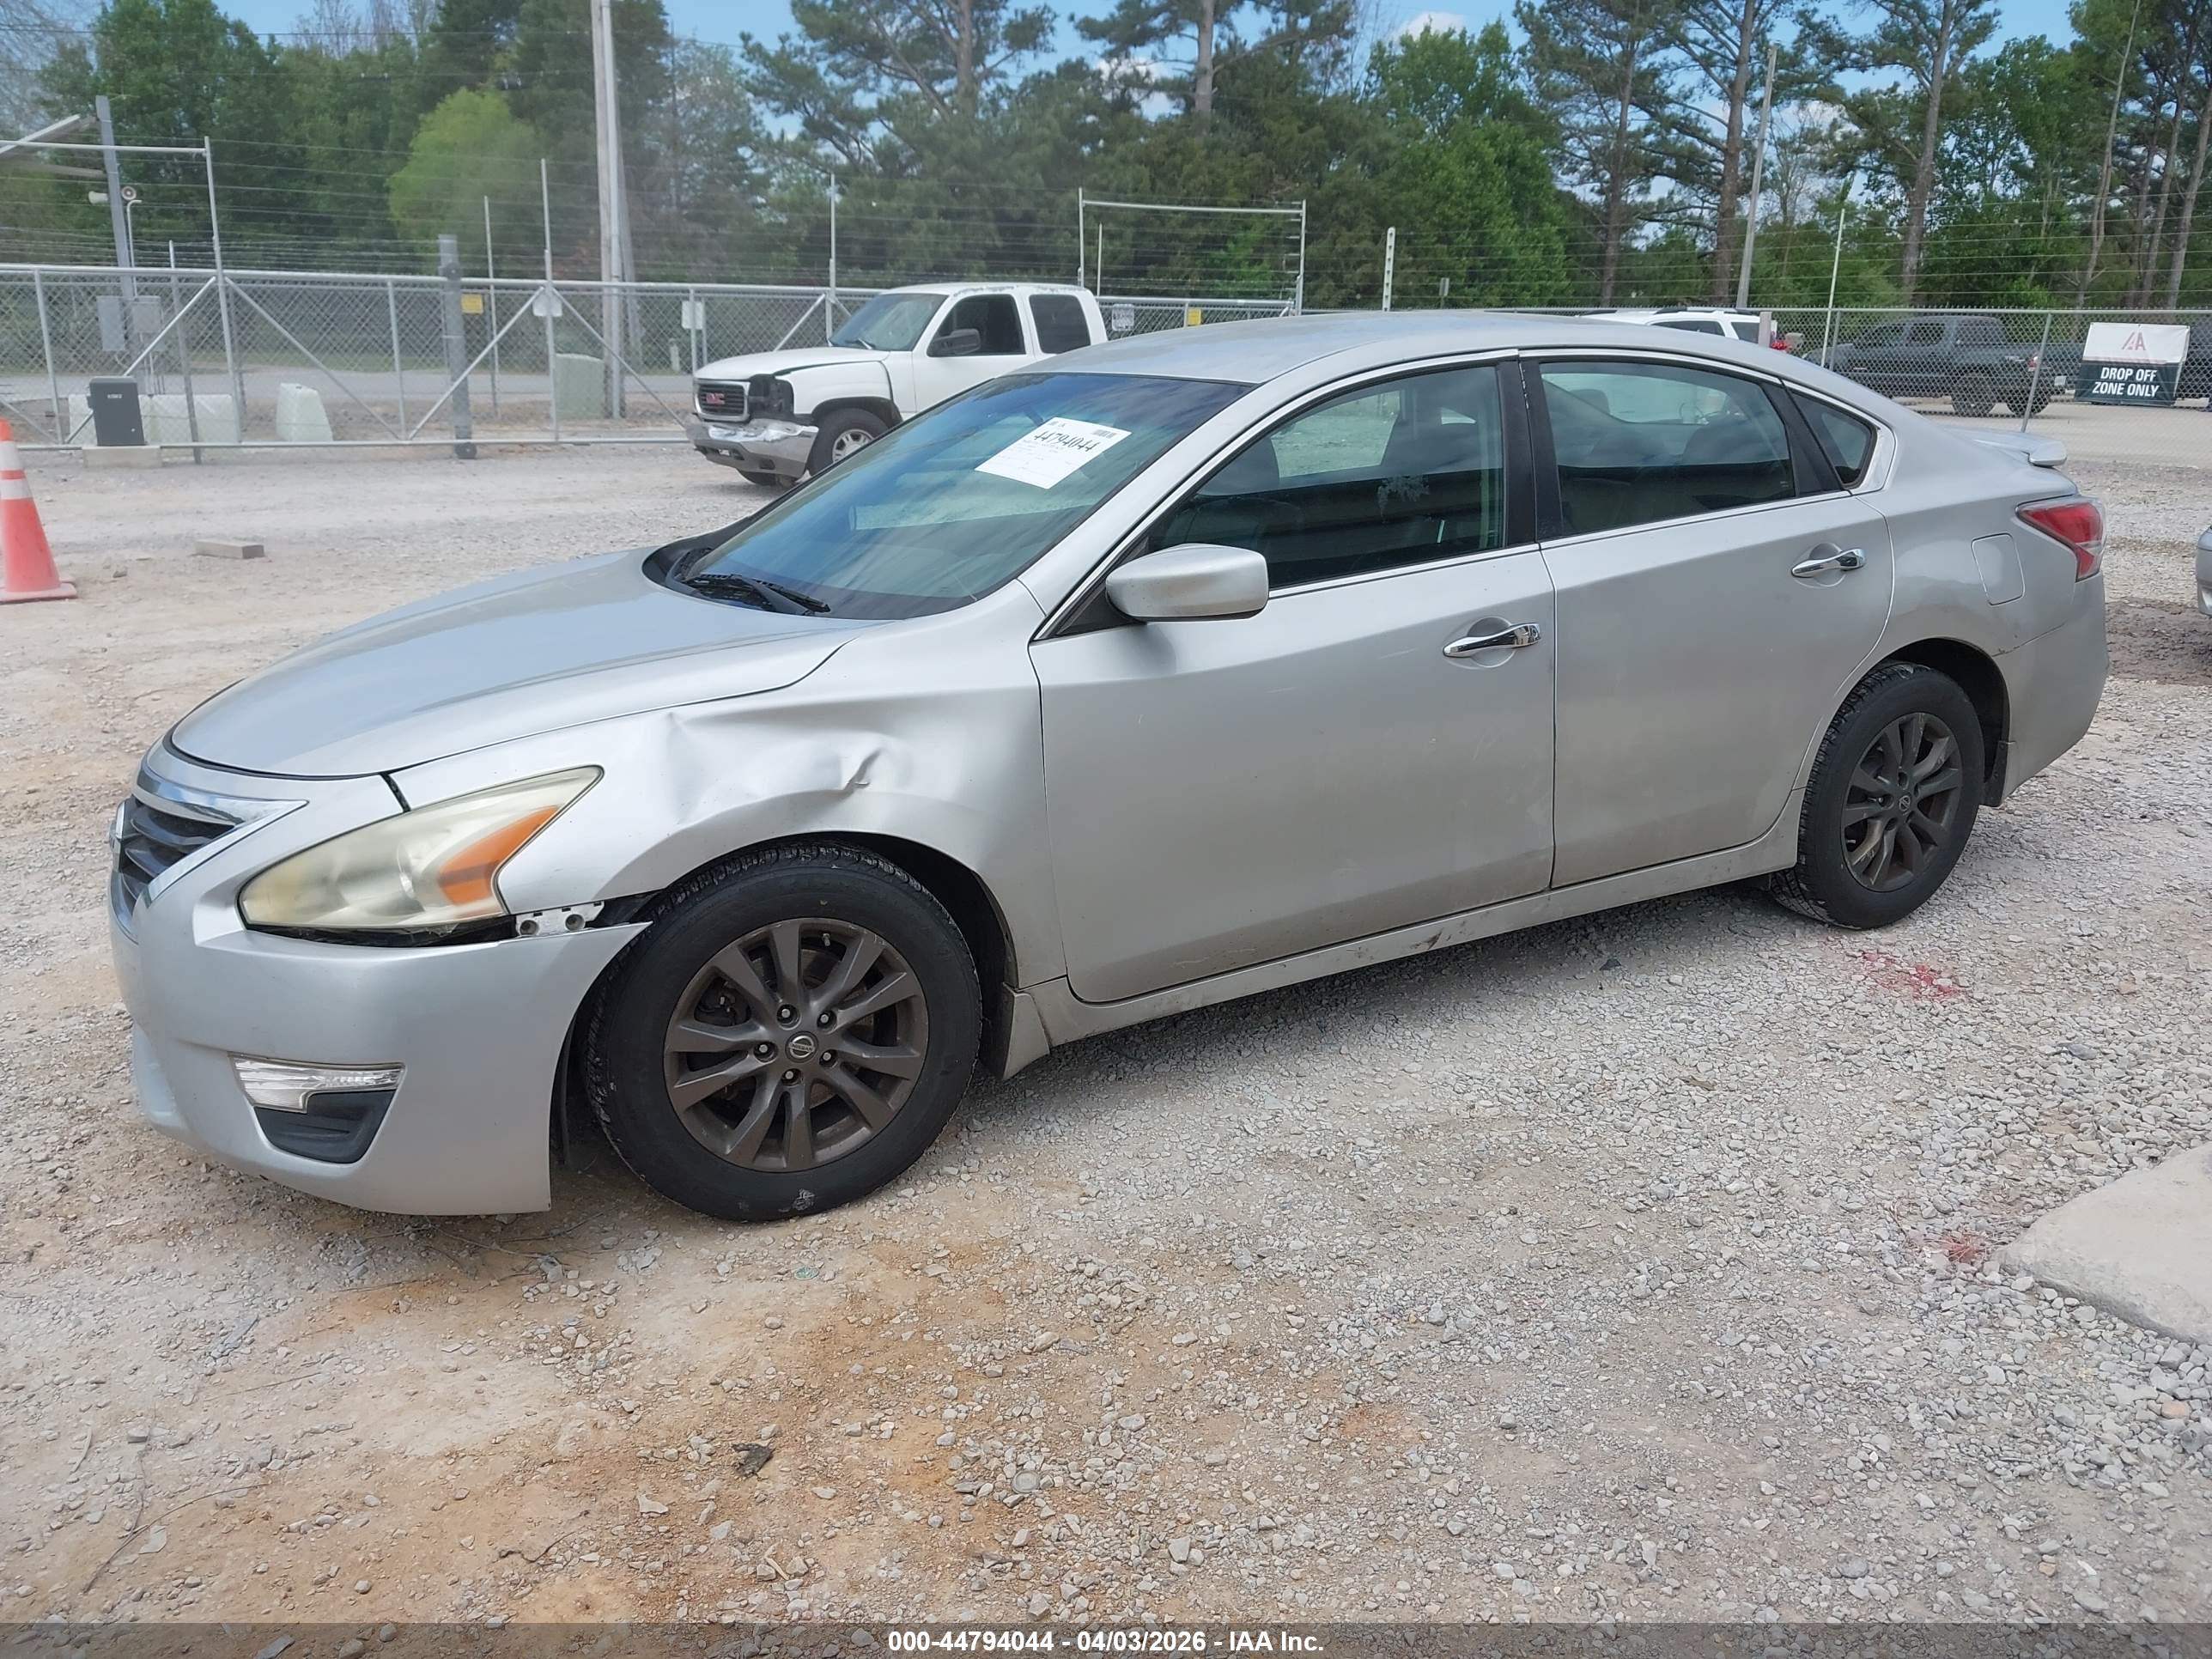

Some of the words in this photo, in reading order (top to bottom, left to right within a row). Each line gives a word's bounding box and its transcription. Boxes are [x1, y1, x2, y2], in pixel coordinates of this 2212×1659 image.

[2100, 367, 2133, 380] DROP
[2136, 369, 2157, 382] OFF
[2092, 381, 2125, 395] ZONE
[2127, 383, 2160, 398] ONLY
[1033, 430, 1101, 453] 44794044
